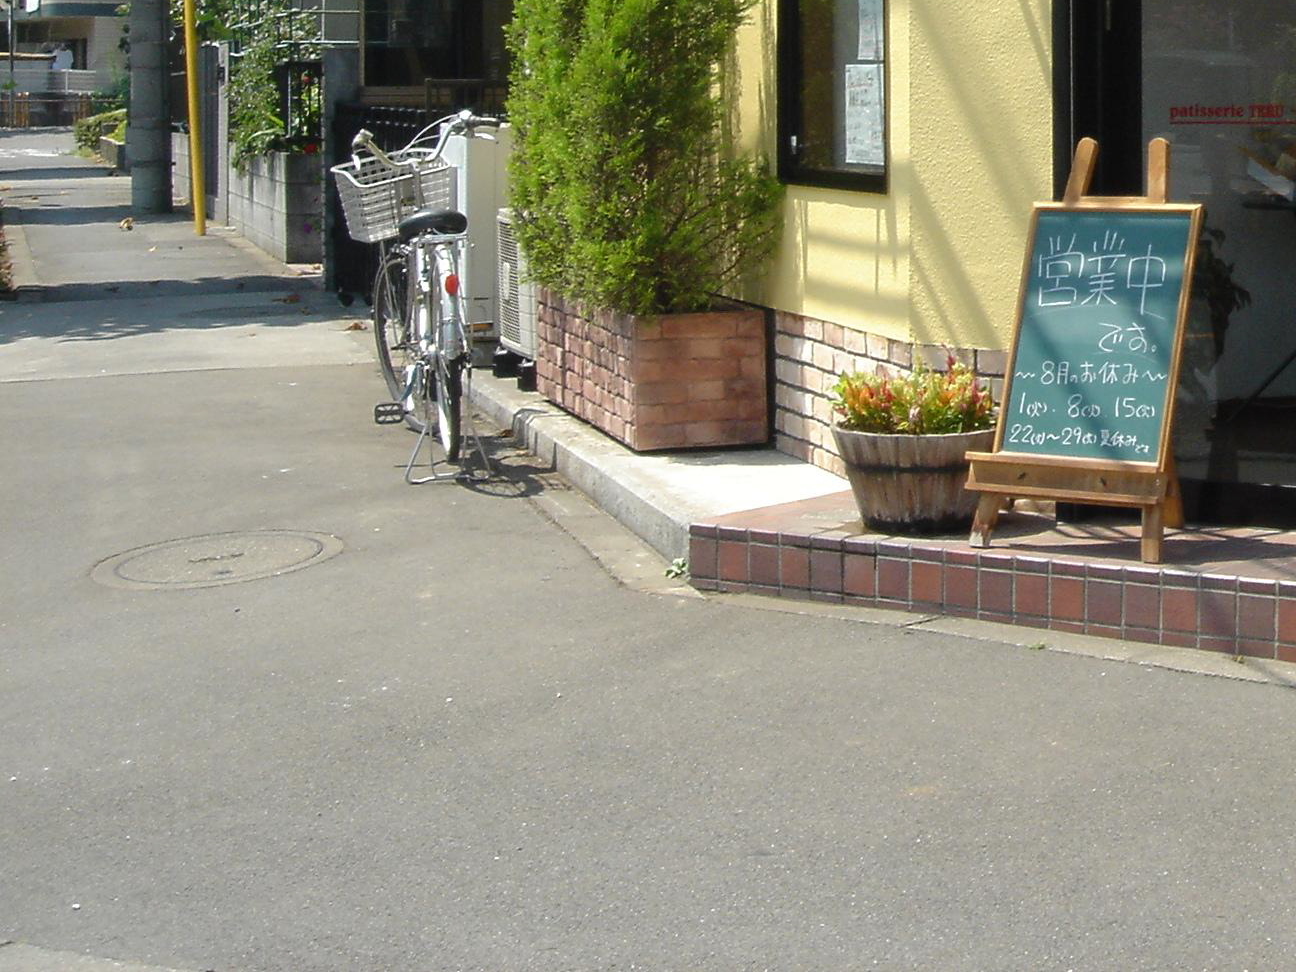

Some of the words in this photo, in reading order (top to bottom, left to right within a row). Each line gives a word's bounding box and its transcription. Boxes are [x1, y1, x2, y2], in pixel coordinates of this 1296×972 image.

[1169, 103, 1244, 120] patisserie
[1038, 230, 1166, 315] 営業中
[1097, 321, 1157, 353] です。
